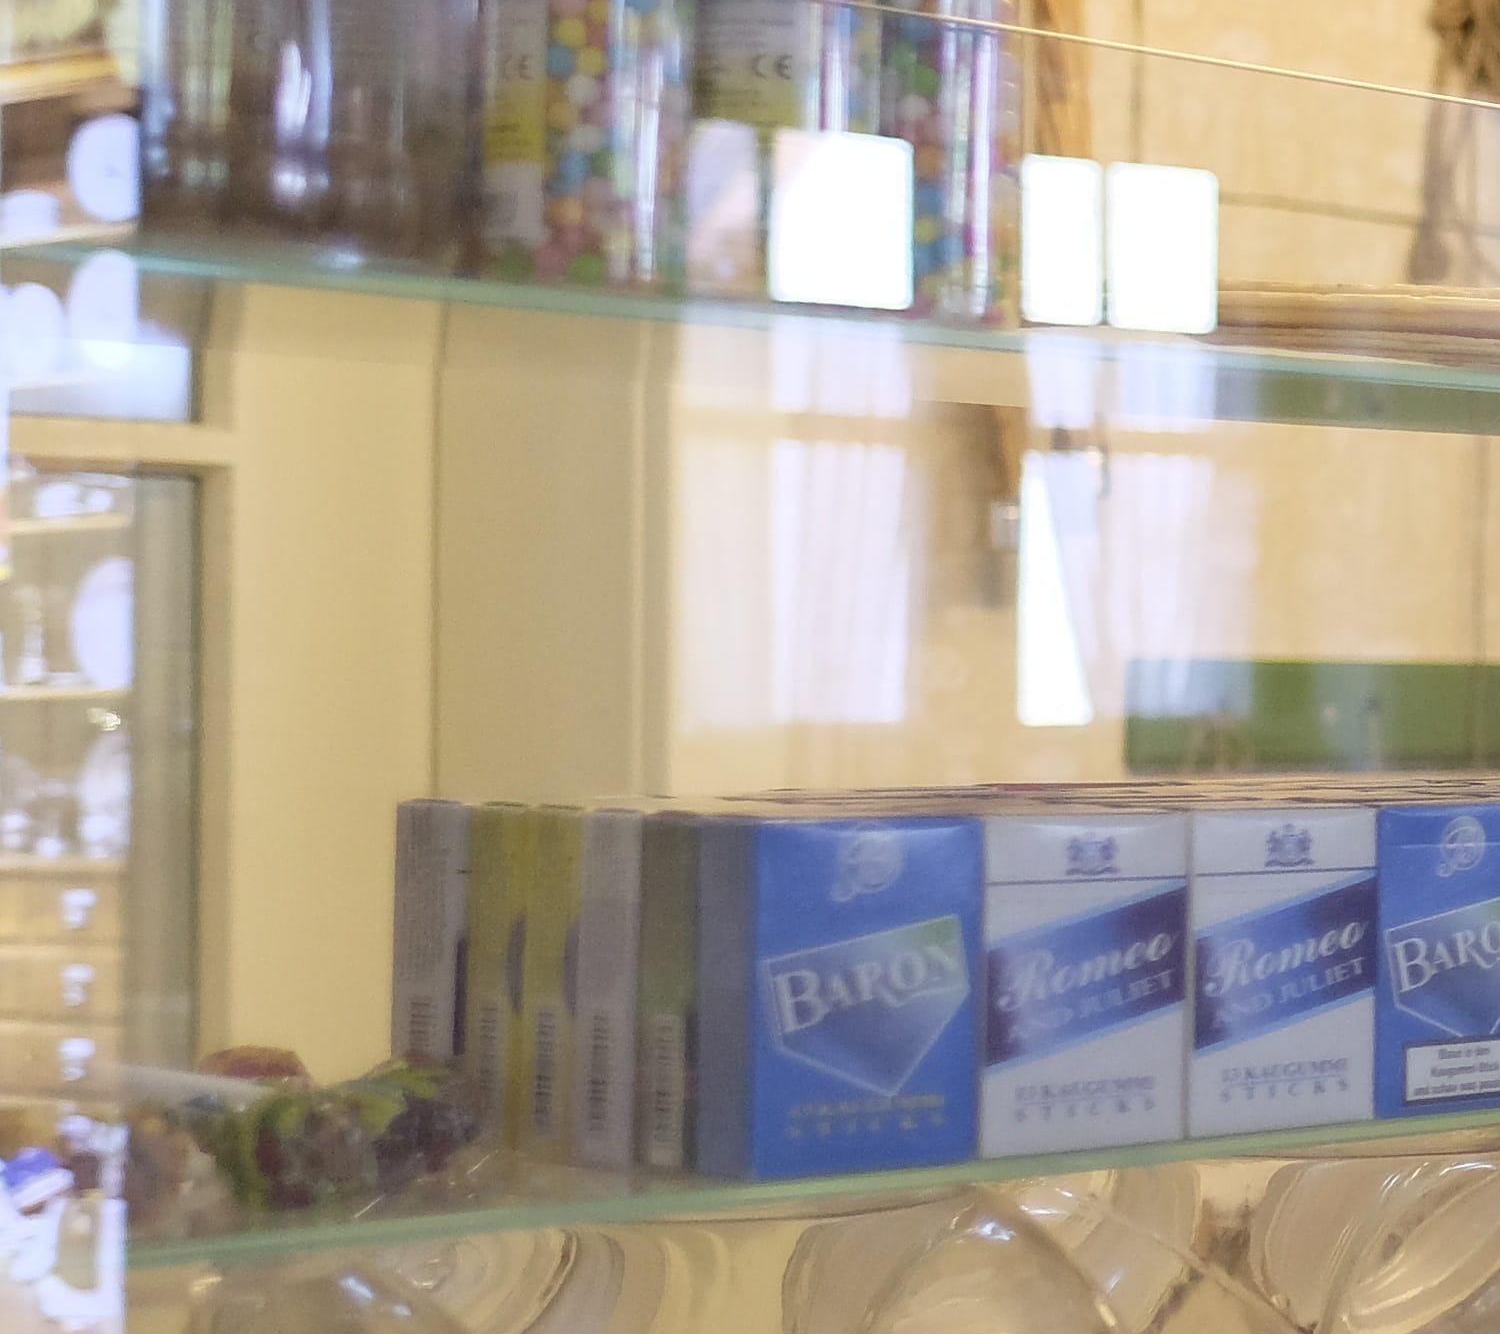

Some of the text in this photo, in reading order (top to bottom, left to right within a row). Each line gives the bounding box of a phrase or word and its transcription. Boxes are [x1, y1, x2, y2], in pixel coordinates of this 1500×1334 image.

[773, 942, 956, 1036] BARON
[999, 932, 1178, 1012] Romeo
[1205, 921, 1369, 998] Romeo
[1280, 957, 1366, 1004] JULIET
